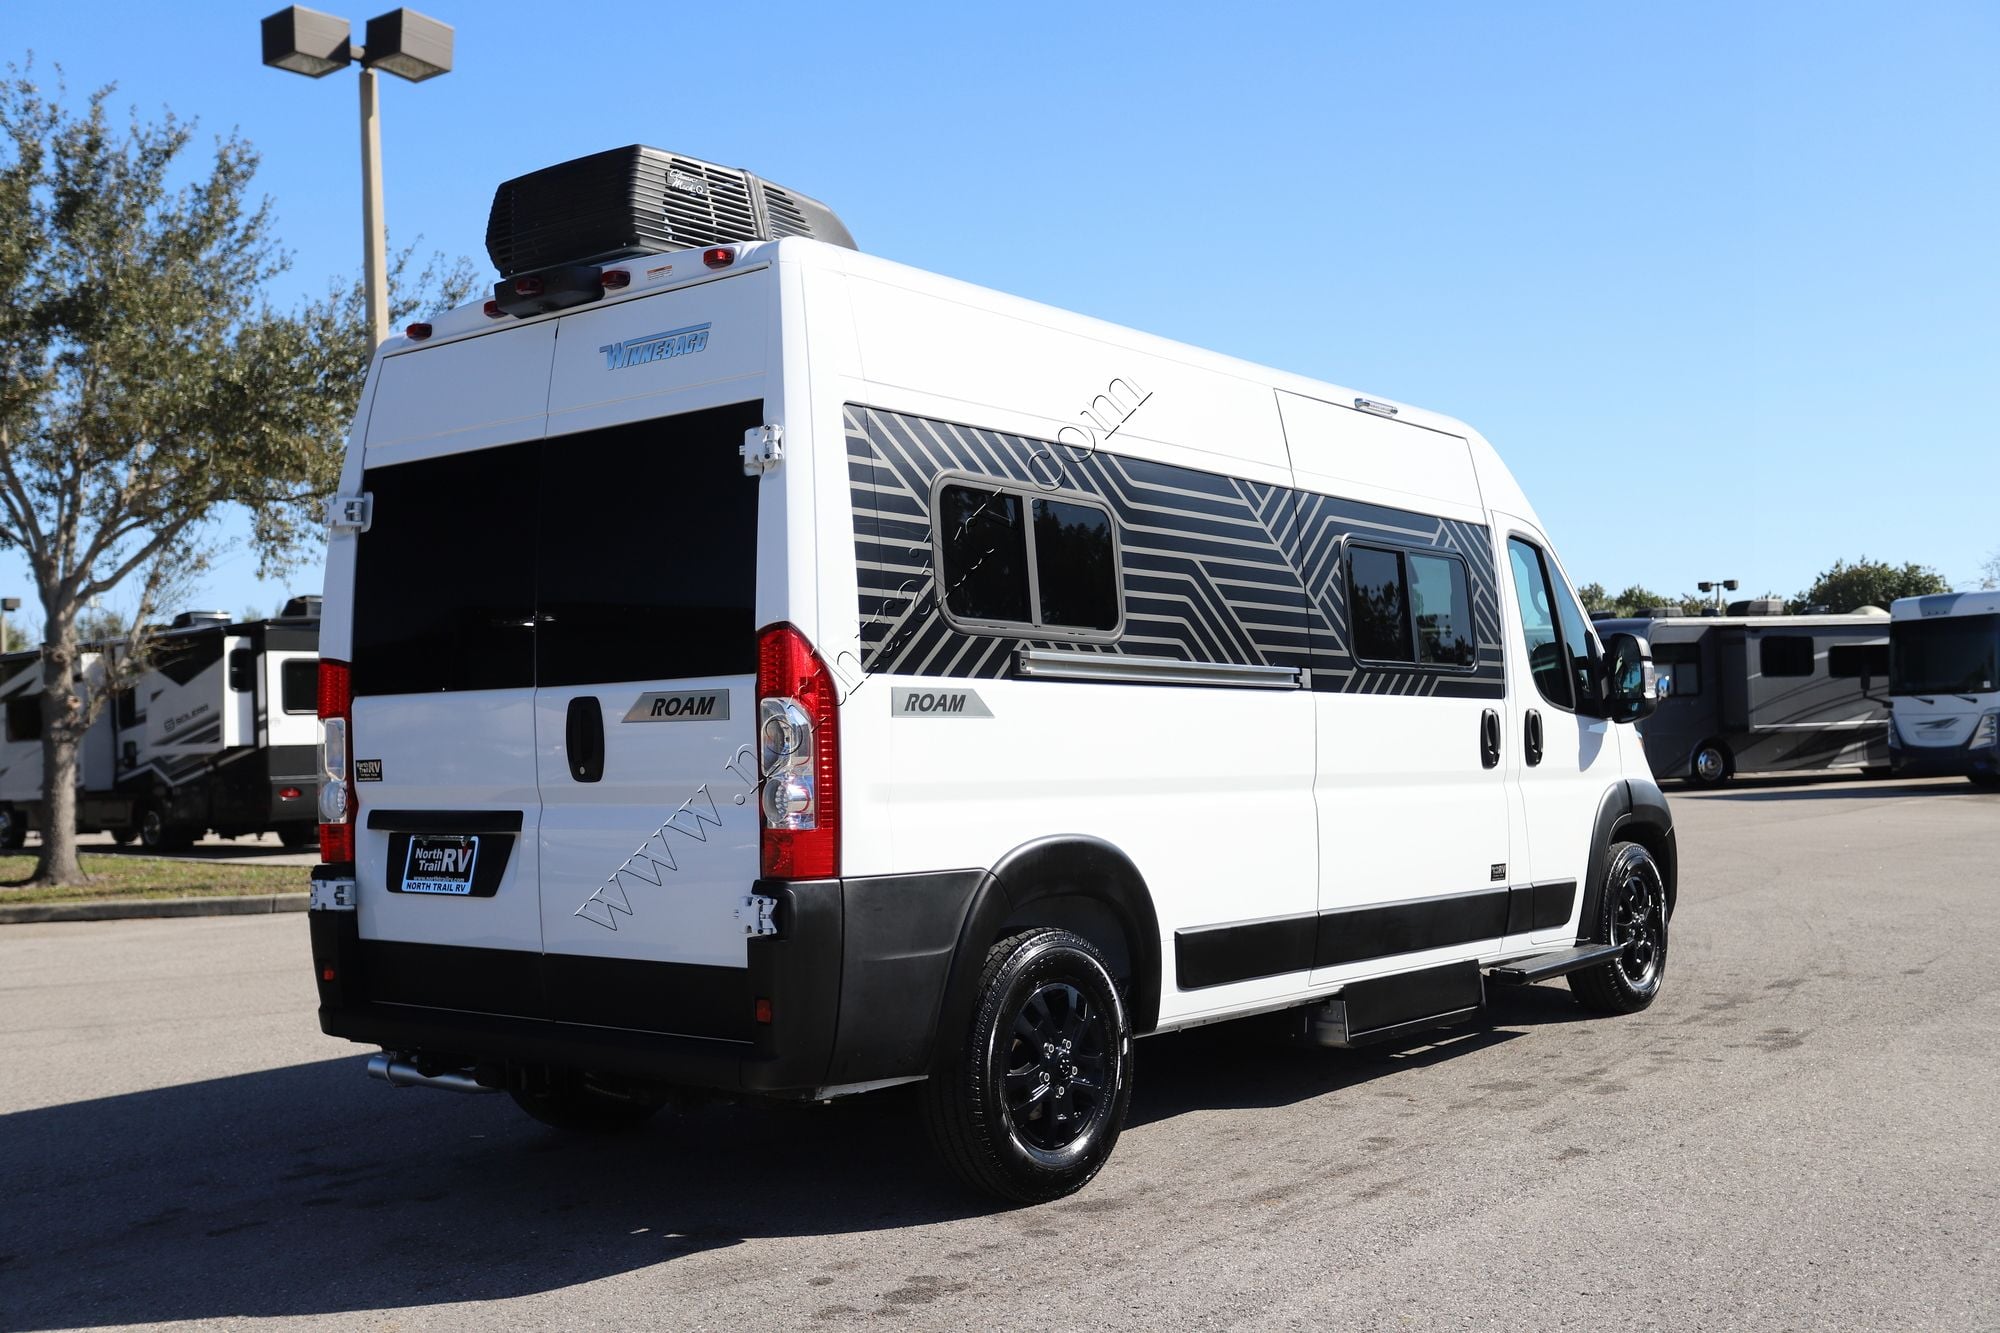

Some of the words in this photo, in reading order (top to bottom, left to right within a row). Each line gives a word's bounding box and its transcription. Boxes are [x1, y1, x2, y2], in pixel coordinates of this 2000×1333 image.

[599, 330, 710, 371] WINNEBAGO
[651, 696, 715, 717] ROAM
[904, 693, 966, 713] ROAM
[415, 847, 443, 860] North
[418, 860, 442, 872] Trail
[441, 848, 472, 873] RV
[406, 881, 431, 891] NORTH
[433, 883, 454, 892] TRAIL
[455, 884, 466, 892] RV
